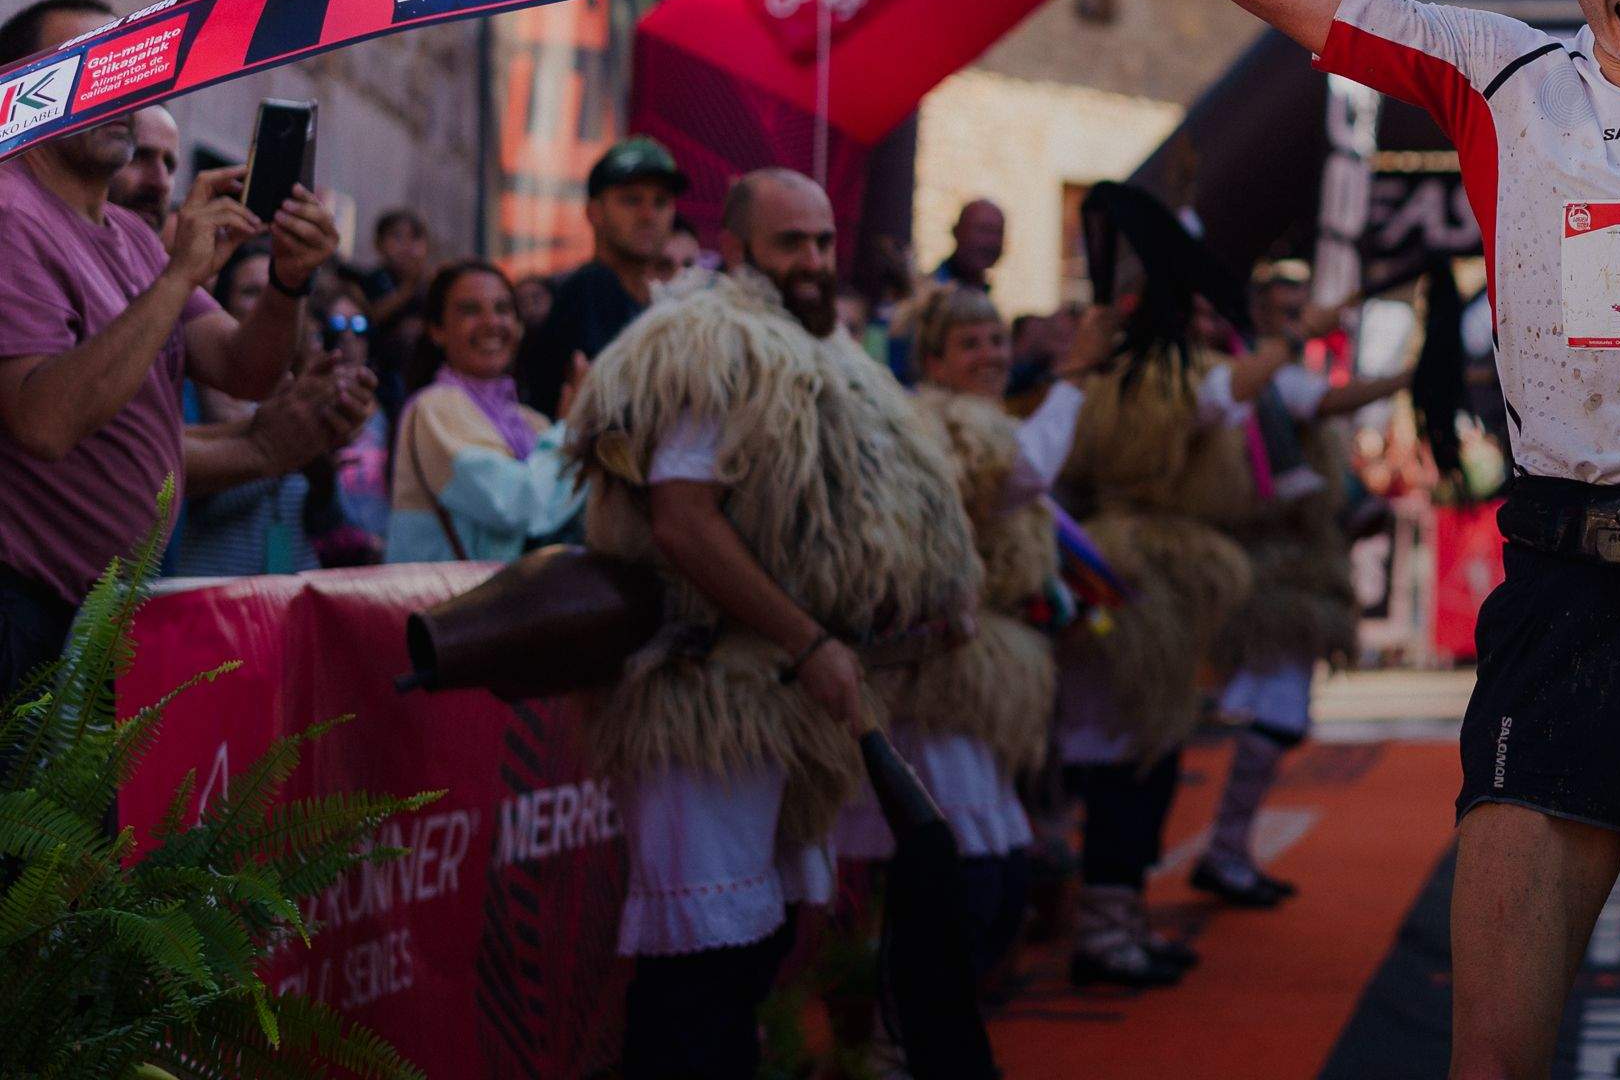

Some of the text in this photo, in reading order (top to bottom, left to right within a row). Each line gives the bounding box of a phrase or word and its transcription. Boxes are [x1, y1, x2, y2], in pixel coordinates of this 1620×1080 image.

[87, 27, 181, 69] Goi-mailako
[92, 42, 169, 78] elikagaiak
[80, 63, 170, 101] calidad superior
[91, 56, 163, 90] Alimentos de
[24, 108, 60, 128] LABEL
[1494, 716, 1512, 788] SALOMON
